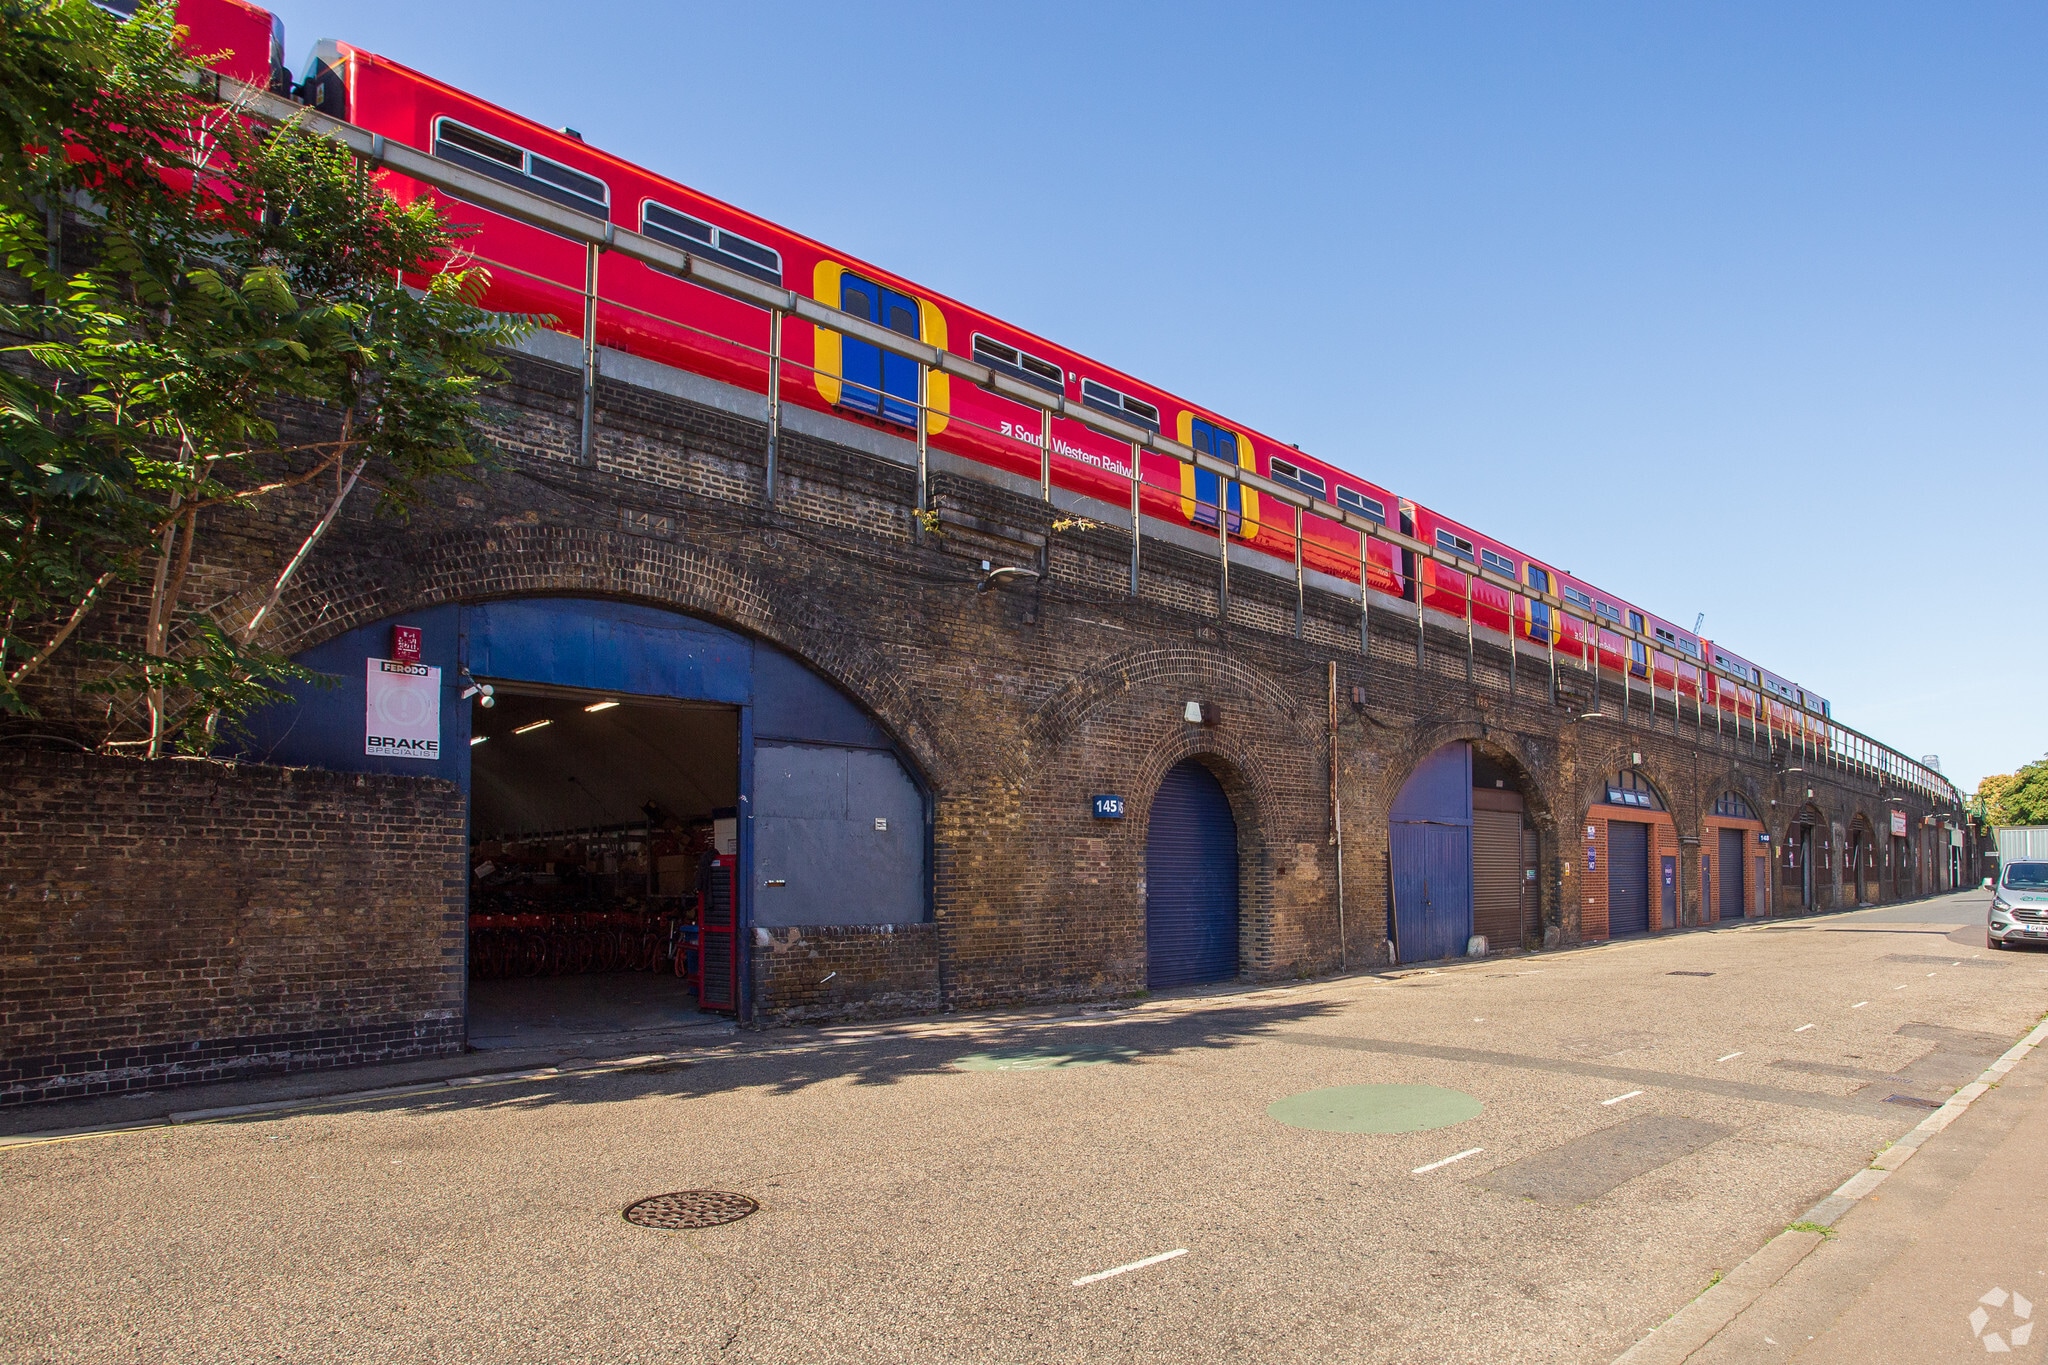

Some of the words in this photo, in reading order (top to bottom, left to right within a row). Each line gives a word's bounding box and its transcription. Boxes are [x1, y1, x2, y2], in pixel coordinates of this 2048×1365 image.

[1015, 424, 1051, 450] Sout
[1052, 437, 1101, 467] Western
[1102, 455, 1144, 482] Railw
[628, 509, 669, 534] 144
[1198, 626, 1217, 640] 145
[384, 662, 427, 675] FERODO
[367, 735, 438, 751] BRAKE
[367, 746, 438, 758] SPECIALIST
[1096, 800, 1117, 812] 145
